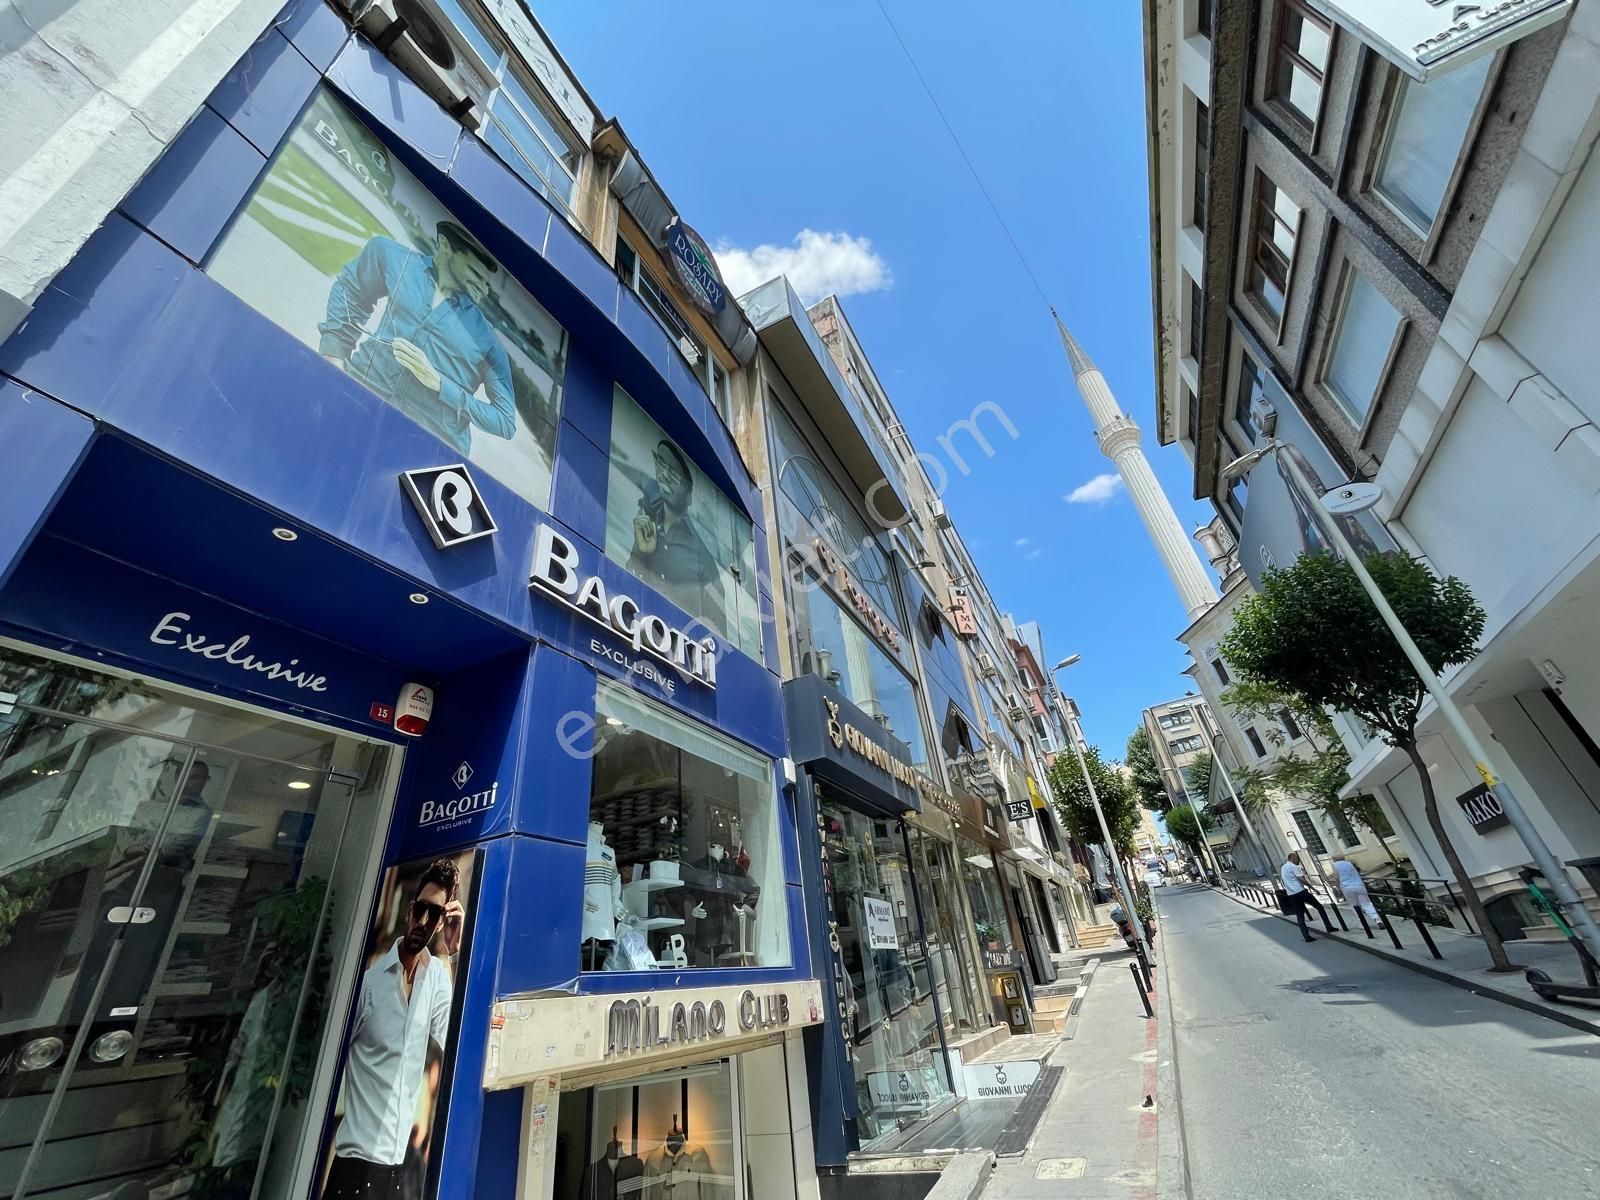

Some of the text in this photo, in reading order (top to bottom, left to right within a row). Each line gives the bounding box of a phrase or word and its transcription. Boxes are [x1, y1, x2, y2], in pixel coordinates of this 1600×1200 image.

[674, 233, 722, 304] ROSARY
[150, 612, 328, 692] Exclusive
[590, 638, 676, 692] EXCLUSIVE
[377, 707, 388, 718] 15
[436, 817, 473, 832] EXCLUSIVE
[978, 1085, 1013, 1097] GIOVANNI
